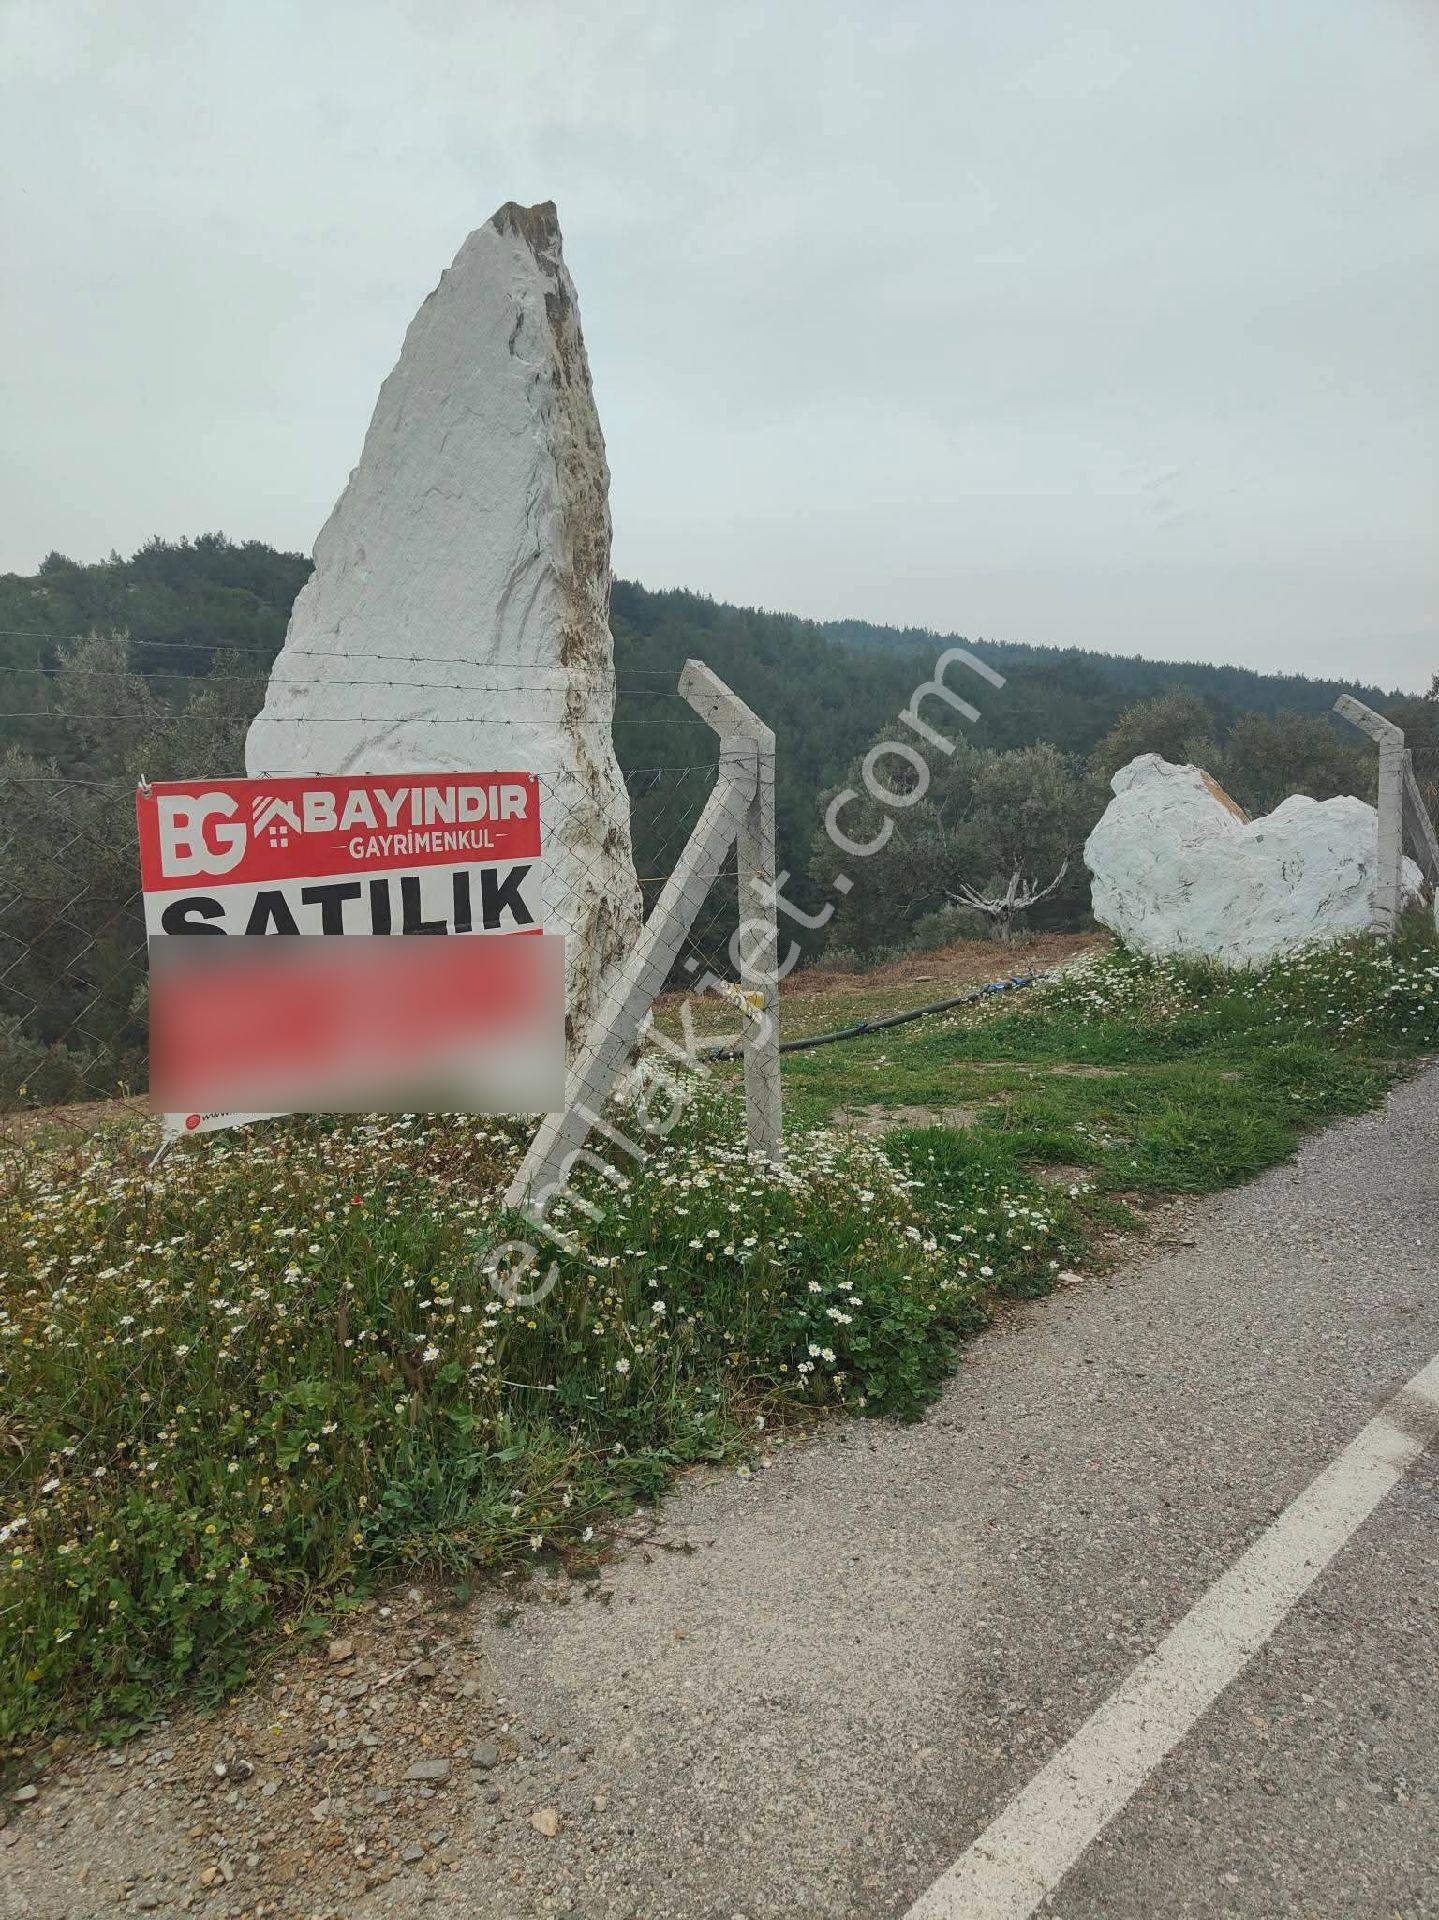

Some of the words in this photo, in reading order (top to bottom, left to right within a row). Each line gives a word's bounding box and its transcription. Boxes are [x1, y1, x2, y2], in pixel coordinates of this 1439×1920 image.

[157, 792, 247, 878] BG
[303, 785, 528, 833] BAYINDIR
[349, 829, 495, 860] GAYRİMENKUL
[161, 864, 534, 935] SATILIK
